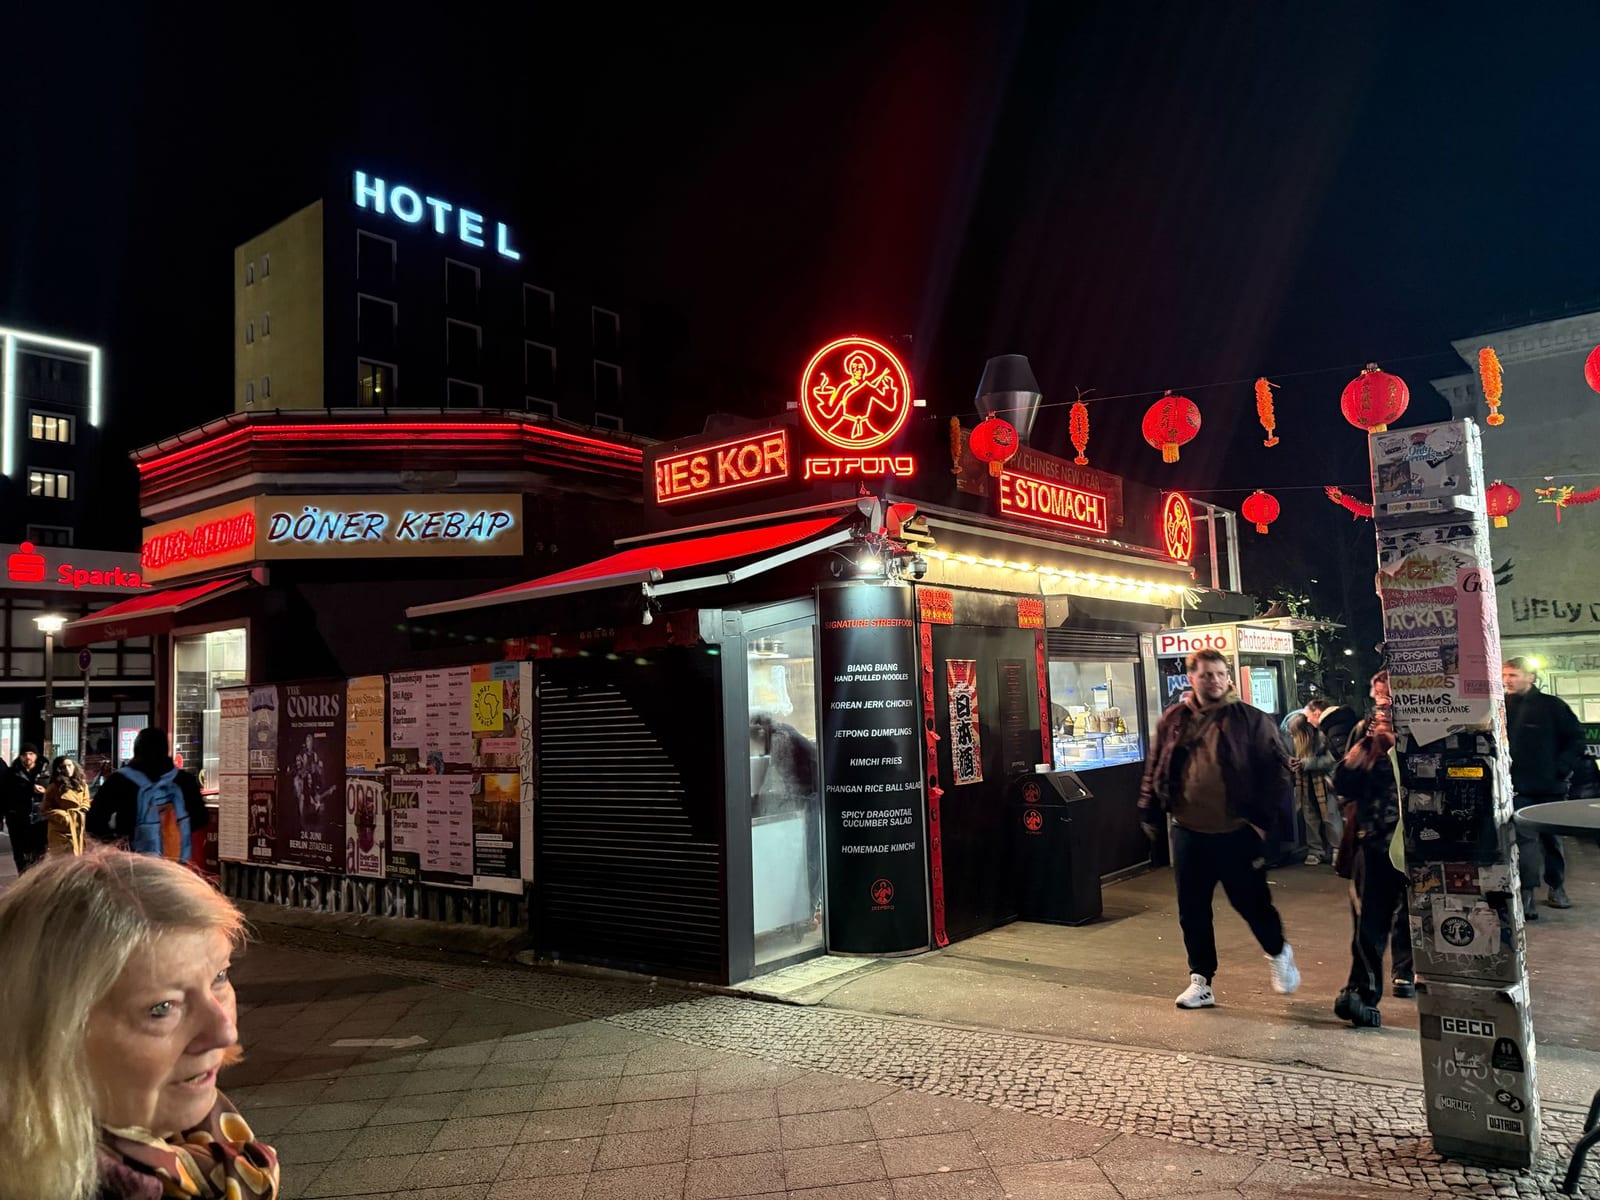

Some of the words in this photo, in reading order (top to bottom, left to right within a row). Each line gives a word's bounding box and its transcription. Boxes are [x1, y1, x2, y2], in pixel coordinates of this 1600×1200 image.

[355, 170, 520, 260] HOTEL
[718, 438, 786, 484] KOR
[1023, 455, 1060, 480] CHINESE
[1061, 466, 1080, 486] NEW
[1079, 470, 1102, 491] YEAR
[1015, 479, 1103, 529] STOMACH,
[267, 506, 386, 541] DÖNER
[395, 510, 511, 540] KEBAP
[57, 564, 152, 589] Sparka
[825, 619, 870, 628] SIGNATURE
[871, 619, 913, 628] STREETFOOD
[1161, 634, 1227, 653] Photo
[847, 664, 873, 673] BIANG
[874, 663, 898, 672] BIANG
[834, 675, 853, 683] HAND
[854, 674, 880, 682] PULLED
[881, 672, 909, 682] NOODLES
[286, 685, 301, 695] THE
[286, 694, 340, 719] CORRS
[830, 701, 861, 711] KOREAN
[863, 700, 885, 710] JERK
[885, 699, 913, 708] CHICKEN
[834, 729, 870, 739] JETPONG
[871, 728, 913, 738] DUMPLINGS
[850, 757, 880, 767] KIMCHI
[881, 756, 903, 766] FRIES
[826, 784, 863, 793] PHANGAN
[864, 783, 884, 793] RICE
[885, 782, 903, 792] BALL
[841, 810, 865, 820] SPICY
[866, 808, 913, 818] DRAGONTAIL
[842, 819, 889, 828] CUCUMBER
[889, 817, 913, 827] SALAD
[289, 840, 308, 849] BERLIN
[841, 844, 889, 854] HOMEMADE
[890, 842, 916, 852] KIMCHI
